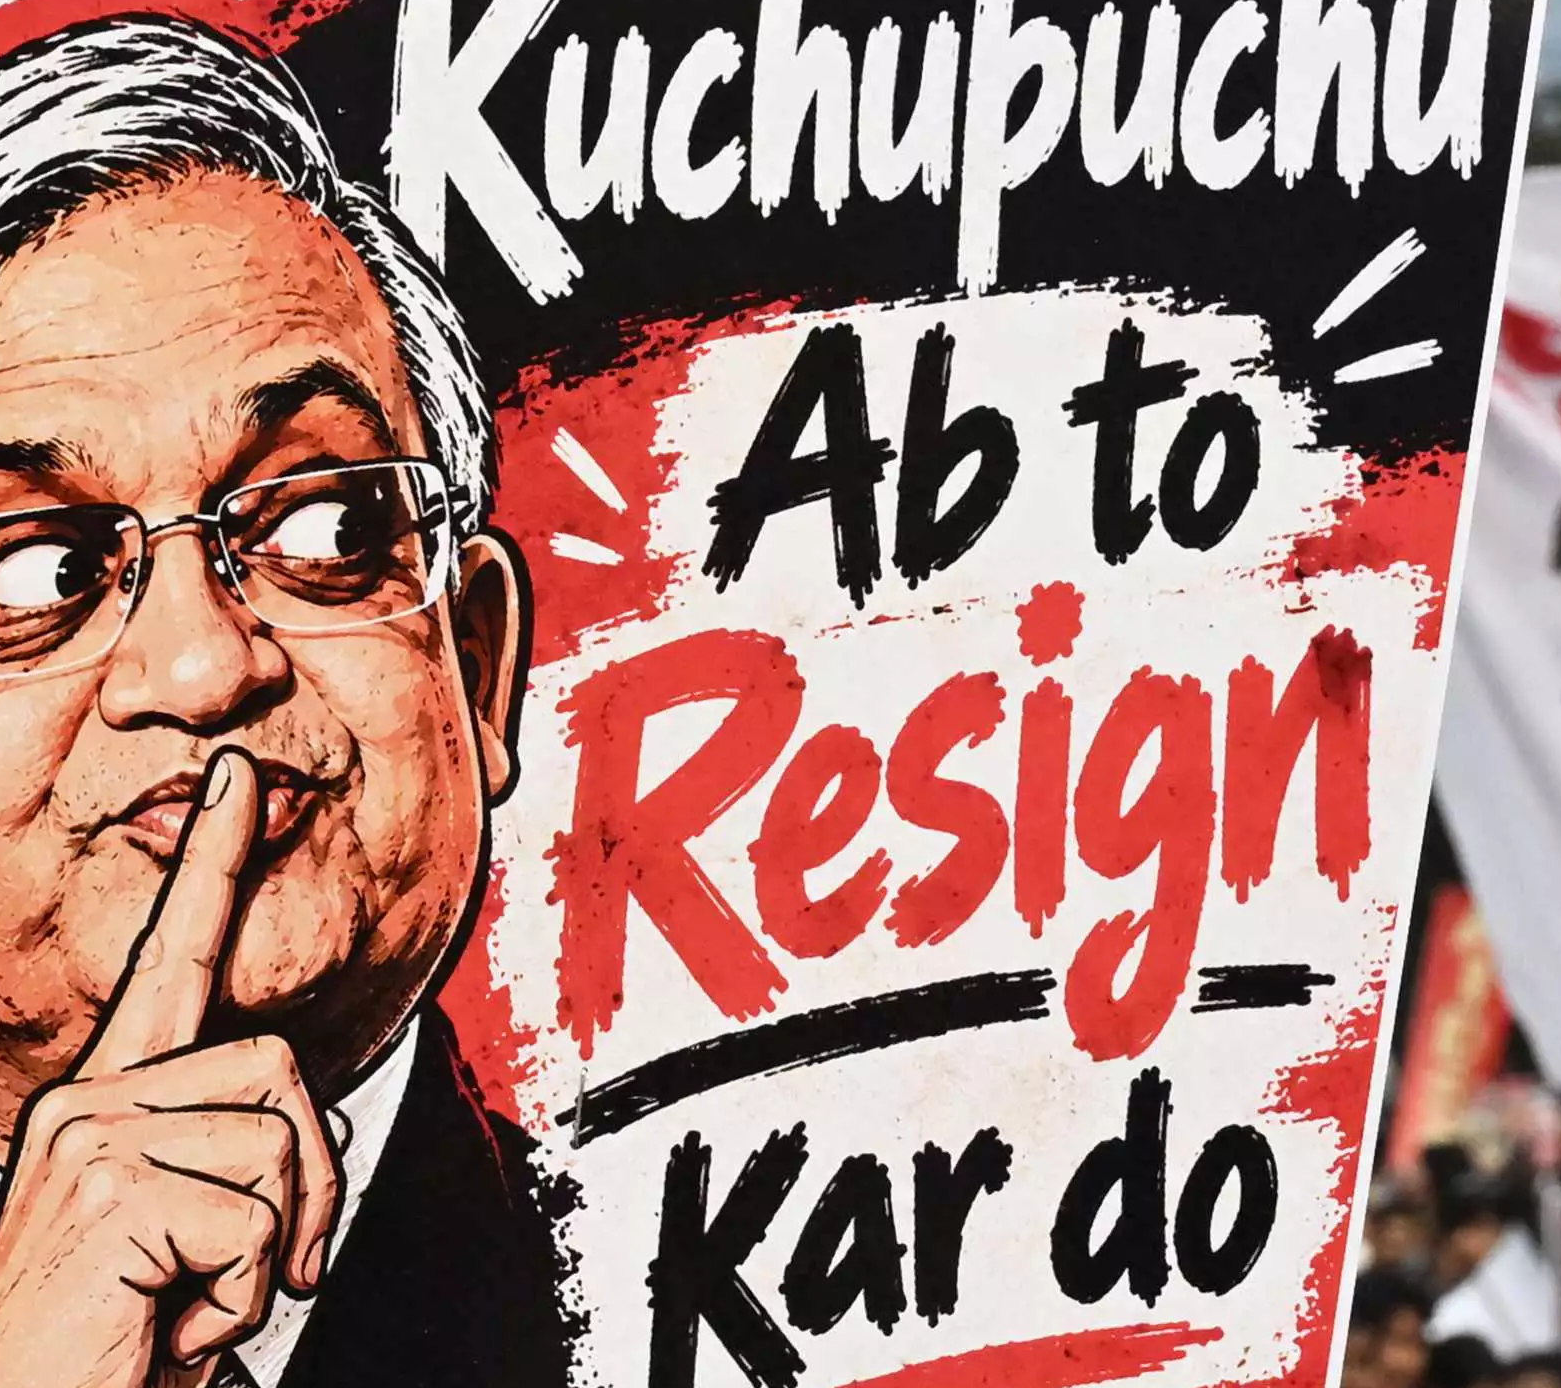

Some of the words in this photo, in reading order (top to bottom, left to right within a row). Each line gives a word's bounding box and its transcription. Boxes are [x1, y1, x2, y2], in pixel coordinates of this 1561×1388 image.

[700, 319, 1021, 608] Ab
[1061, 318, 1263, 566] to
[545, 580, 1374, 1062] Resign
[1050, 1065, 1279, 1308] do
